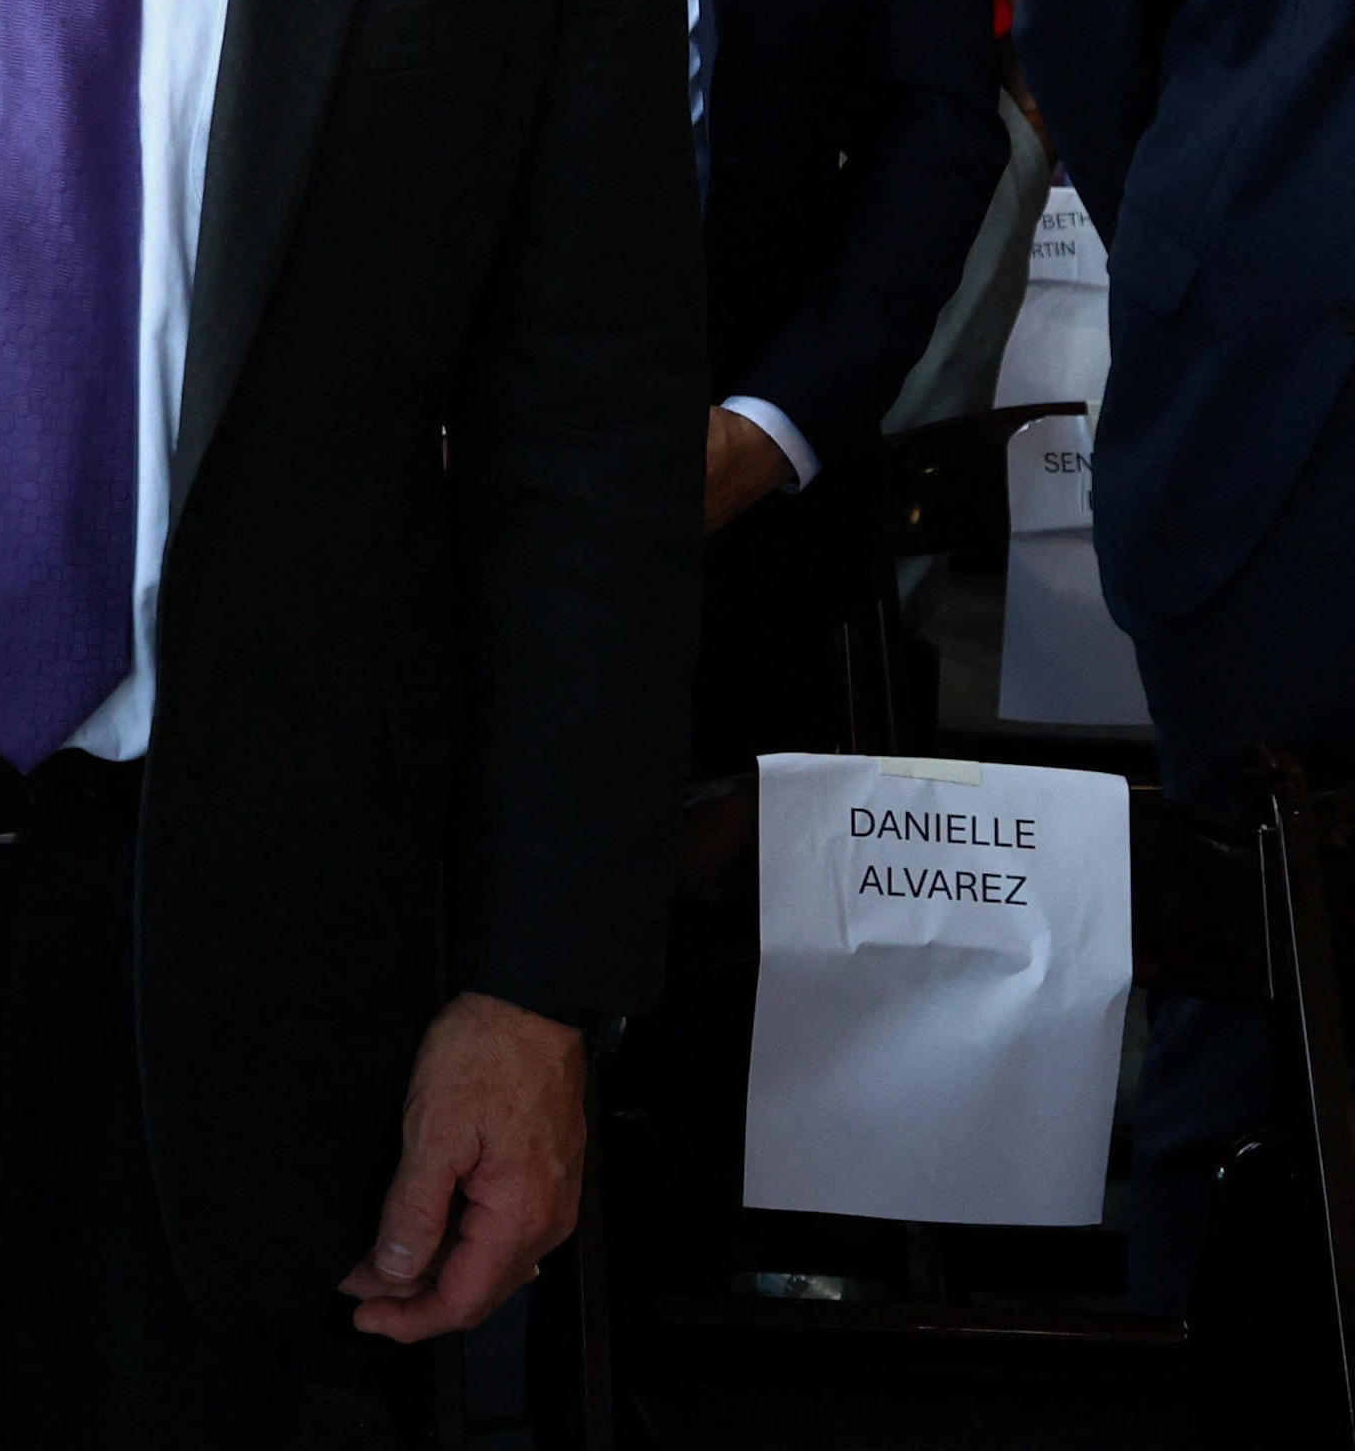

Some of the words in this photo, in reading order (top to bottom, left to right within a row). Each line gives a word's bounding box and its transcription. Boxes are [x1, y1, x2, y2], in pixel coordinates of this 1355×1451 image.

[1032, 240, 1076, 259] RTIN
[849, 806, 1037, 851] DANIELLE
[857, 864, 1029, 907] ALVAREZ
